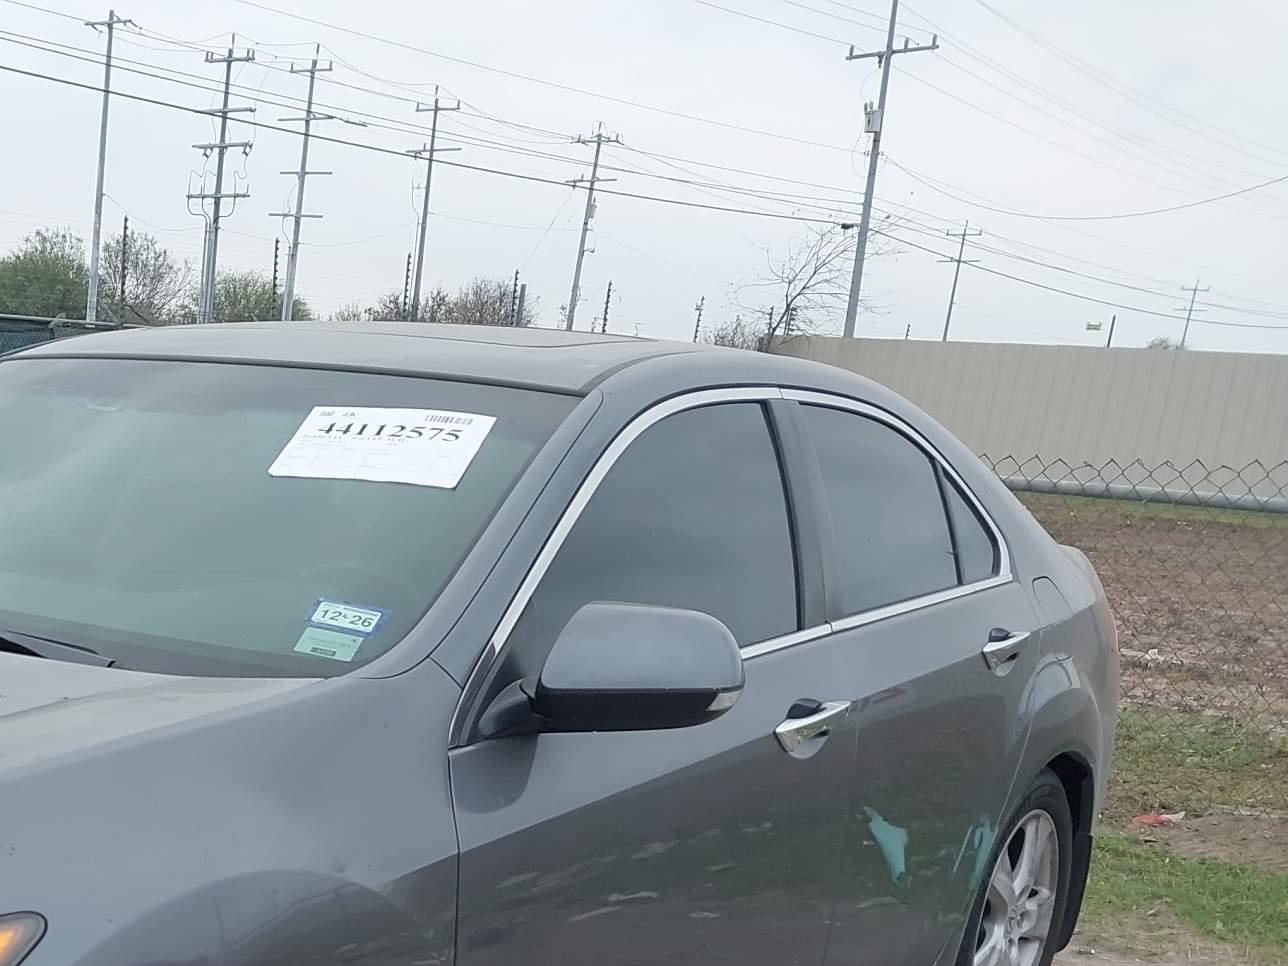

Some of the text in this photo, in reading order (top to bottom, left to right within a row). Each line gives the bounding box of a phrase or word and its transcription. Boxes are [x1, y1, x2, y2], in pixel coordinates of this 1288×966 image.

[318, 422, 464, 441] 44112575
[321, 609, 342, 621] 12
[349, 615, 374, 627] 26
